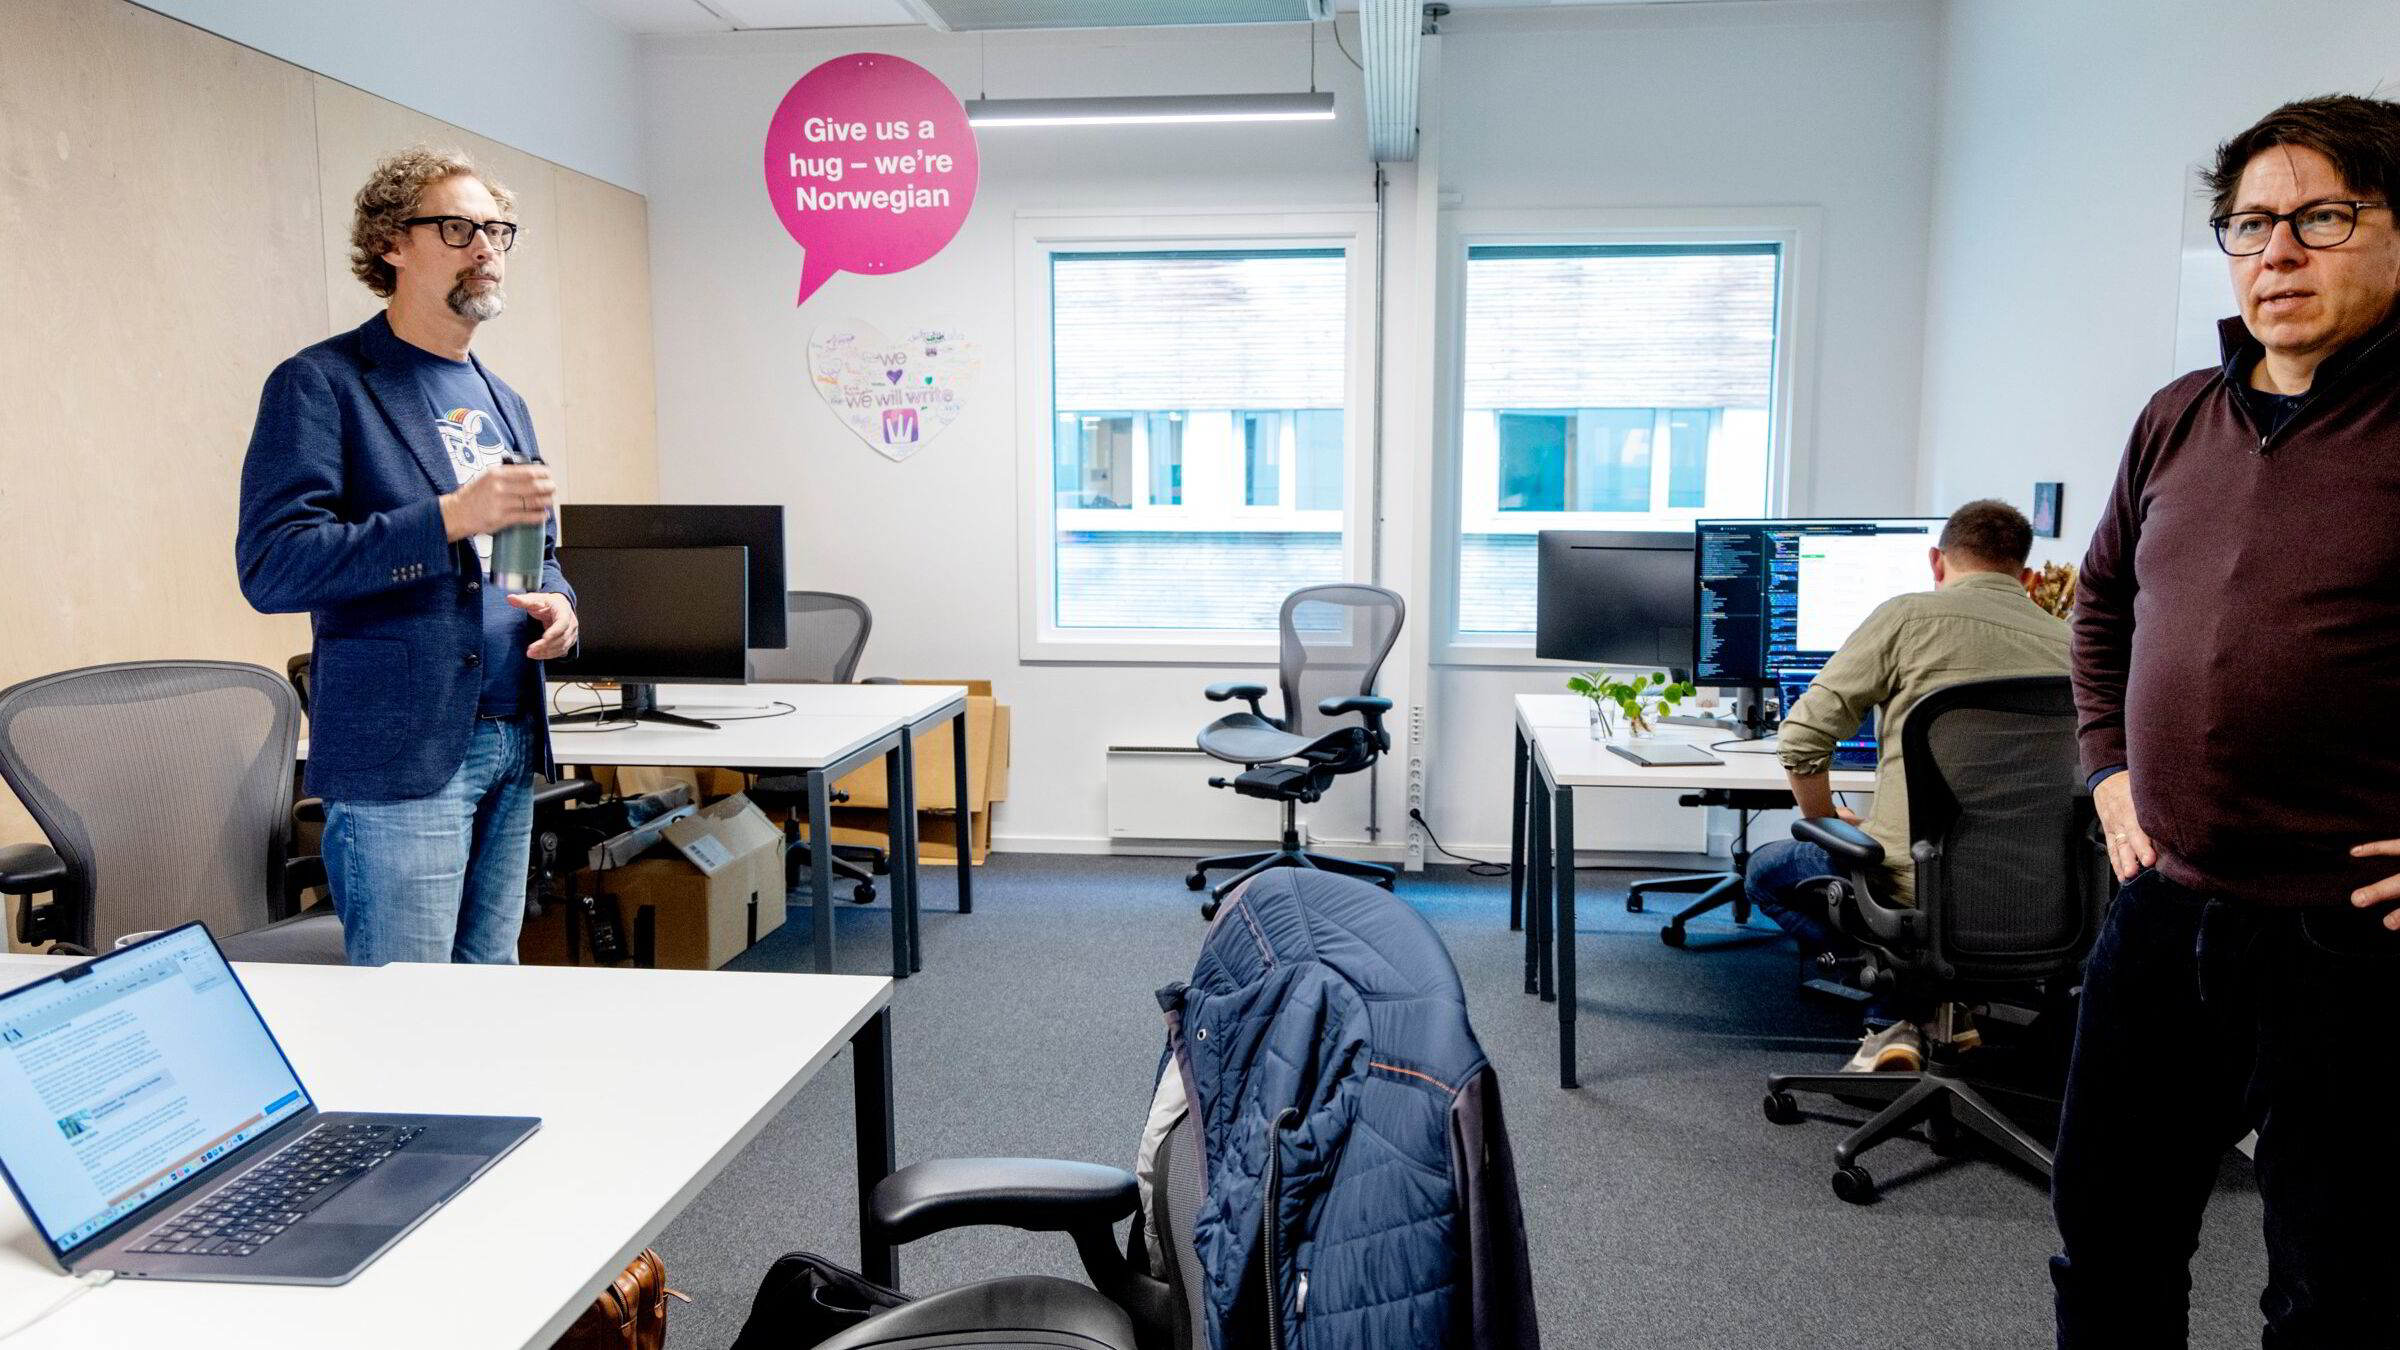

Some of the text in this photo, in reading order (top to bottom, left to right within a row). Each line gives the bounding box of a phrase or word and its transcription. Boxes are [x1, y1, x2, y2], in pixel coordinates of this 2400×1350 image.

[804, 117, 935, 142] Give us a
[789, 153, 843, 182] hug
[874, 149, 953, 175] we’re
[796, 184, 950, 214] Norwegian
[879, 351, 907, 366] we
[845, 386, 953, 409] we will write
